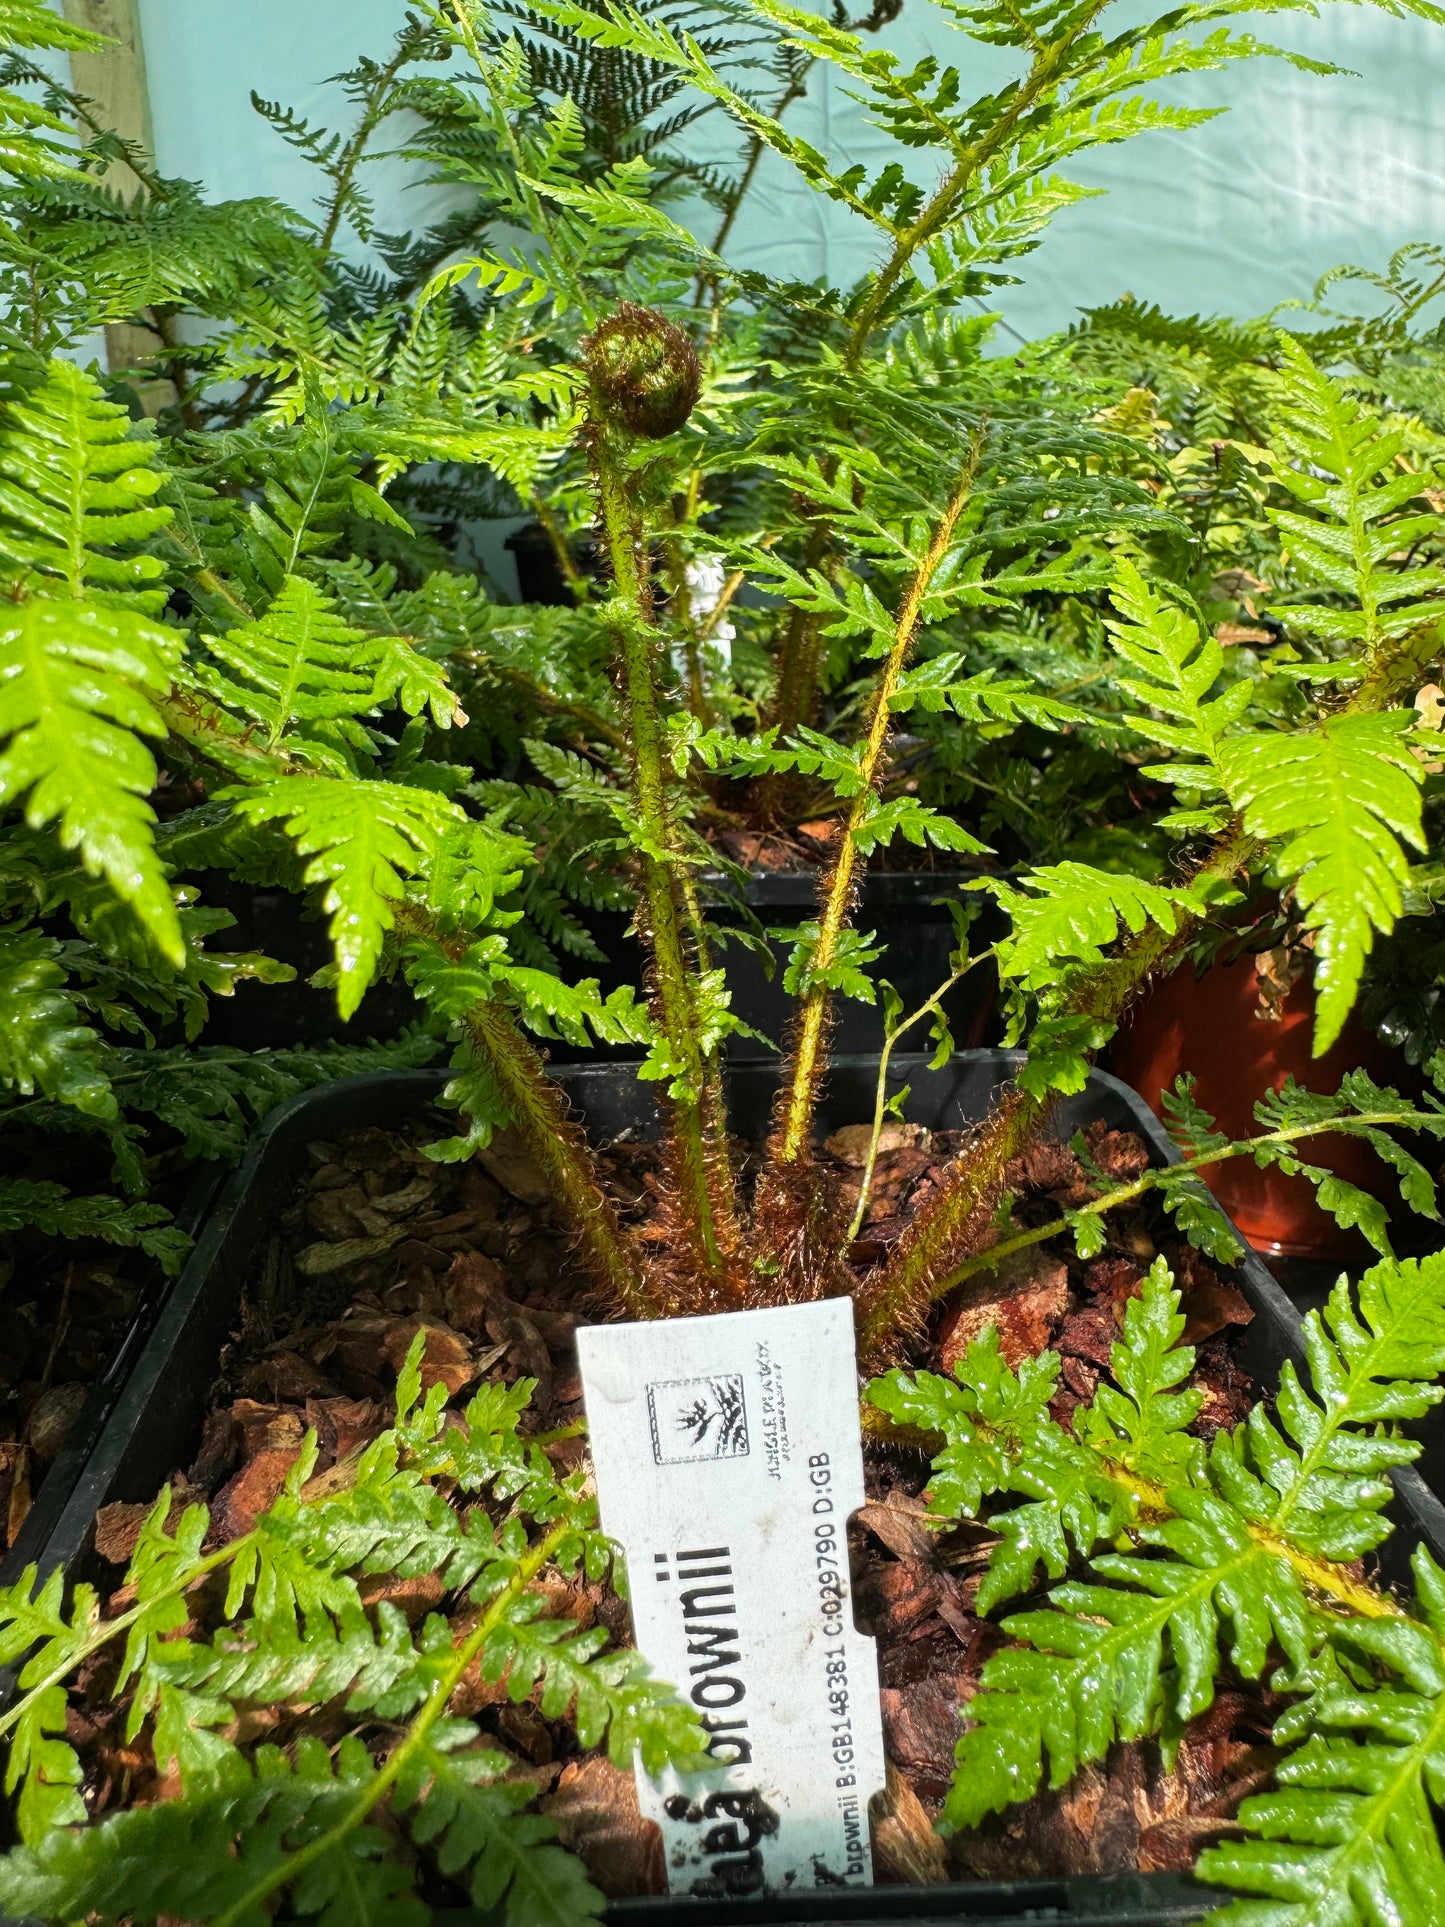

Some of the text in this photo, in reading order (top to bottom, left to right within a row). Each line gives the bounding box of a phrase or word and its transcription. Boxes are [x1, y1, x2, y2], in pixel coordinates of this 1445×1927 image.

[654, 1545, 753, 1764] brownii
[808, 1452, 865, 1876] brownii B:GB148381 C:029790 D:GB
